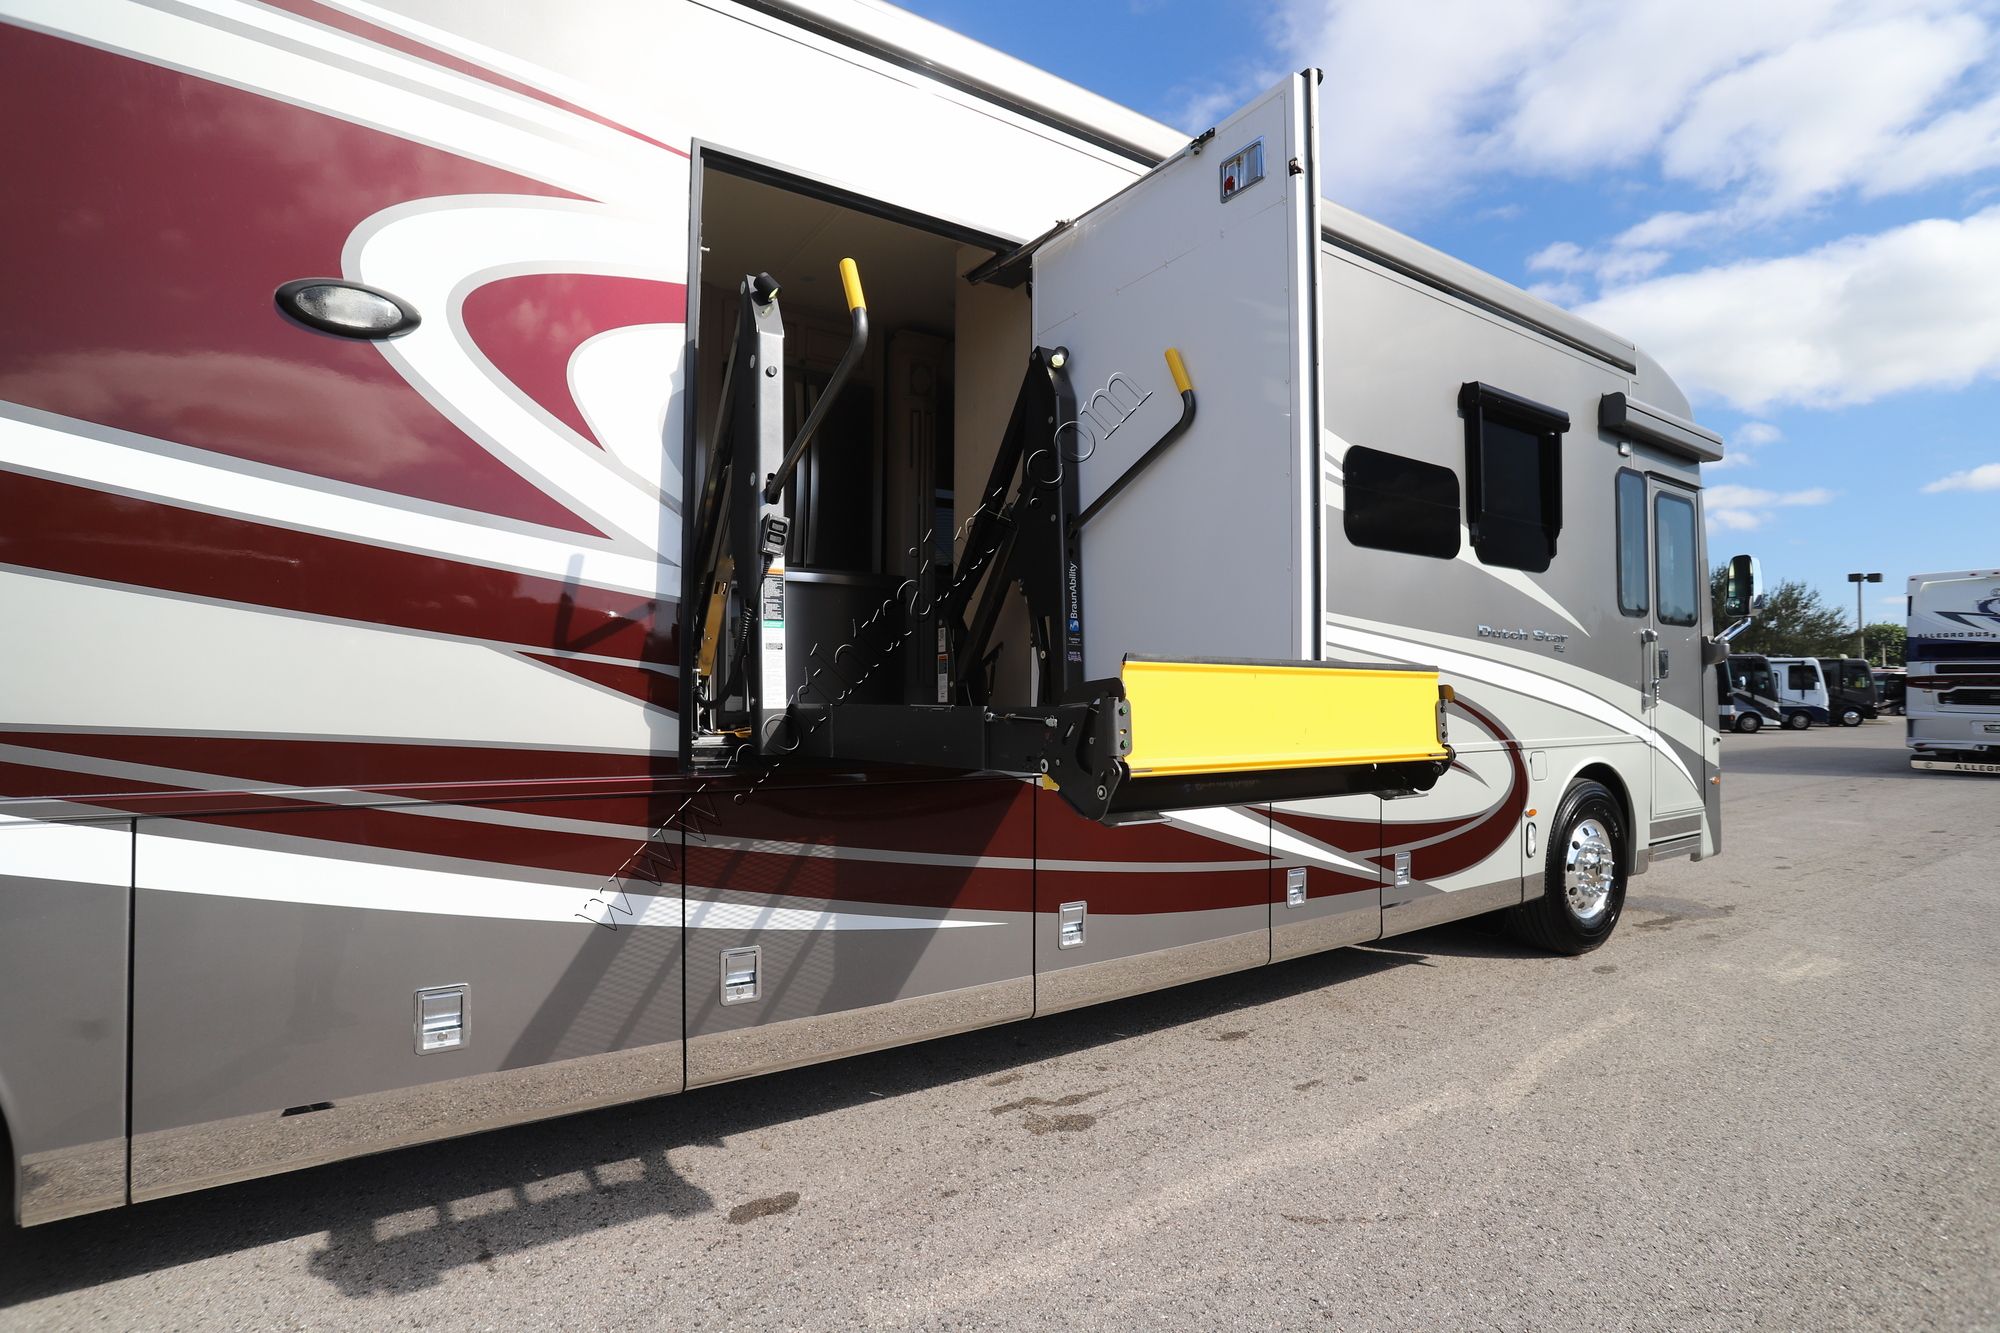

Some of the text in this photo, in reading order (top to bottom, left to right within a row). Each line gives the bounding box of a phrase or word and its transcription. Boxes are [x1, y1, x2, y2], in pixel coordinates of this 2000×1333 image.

[1068, 562, 1078, 619] BraunAbility
[1477, 624, 1568, 643] Dutch Star
